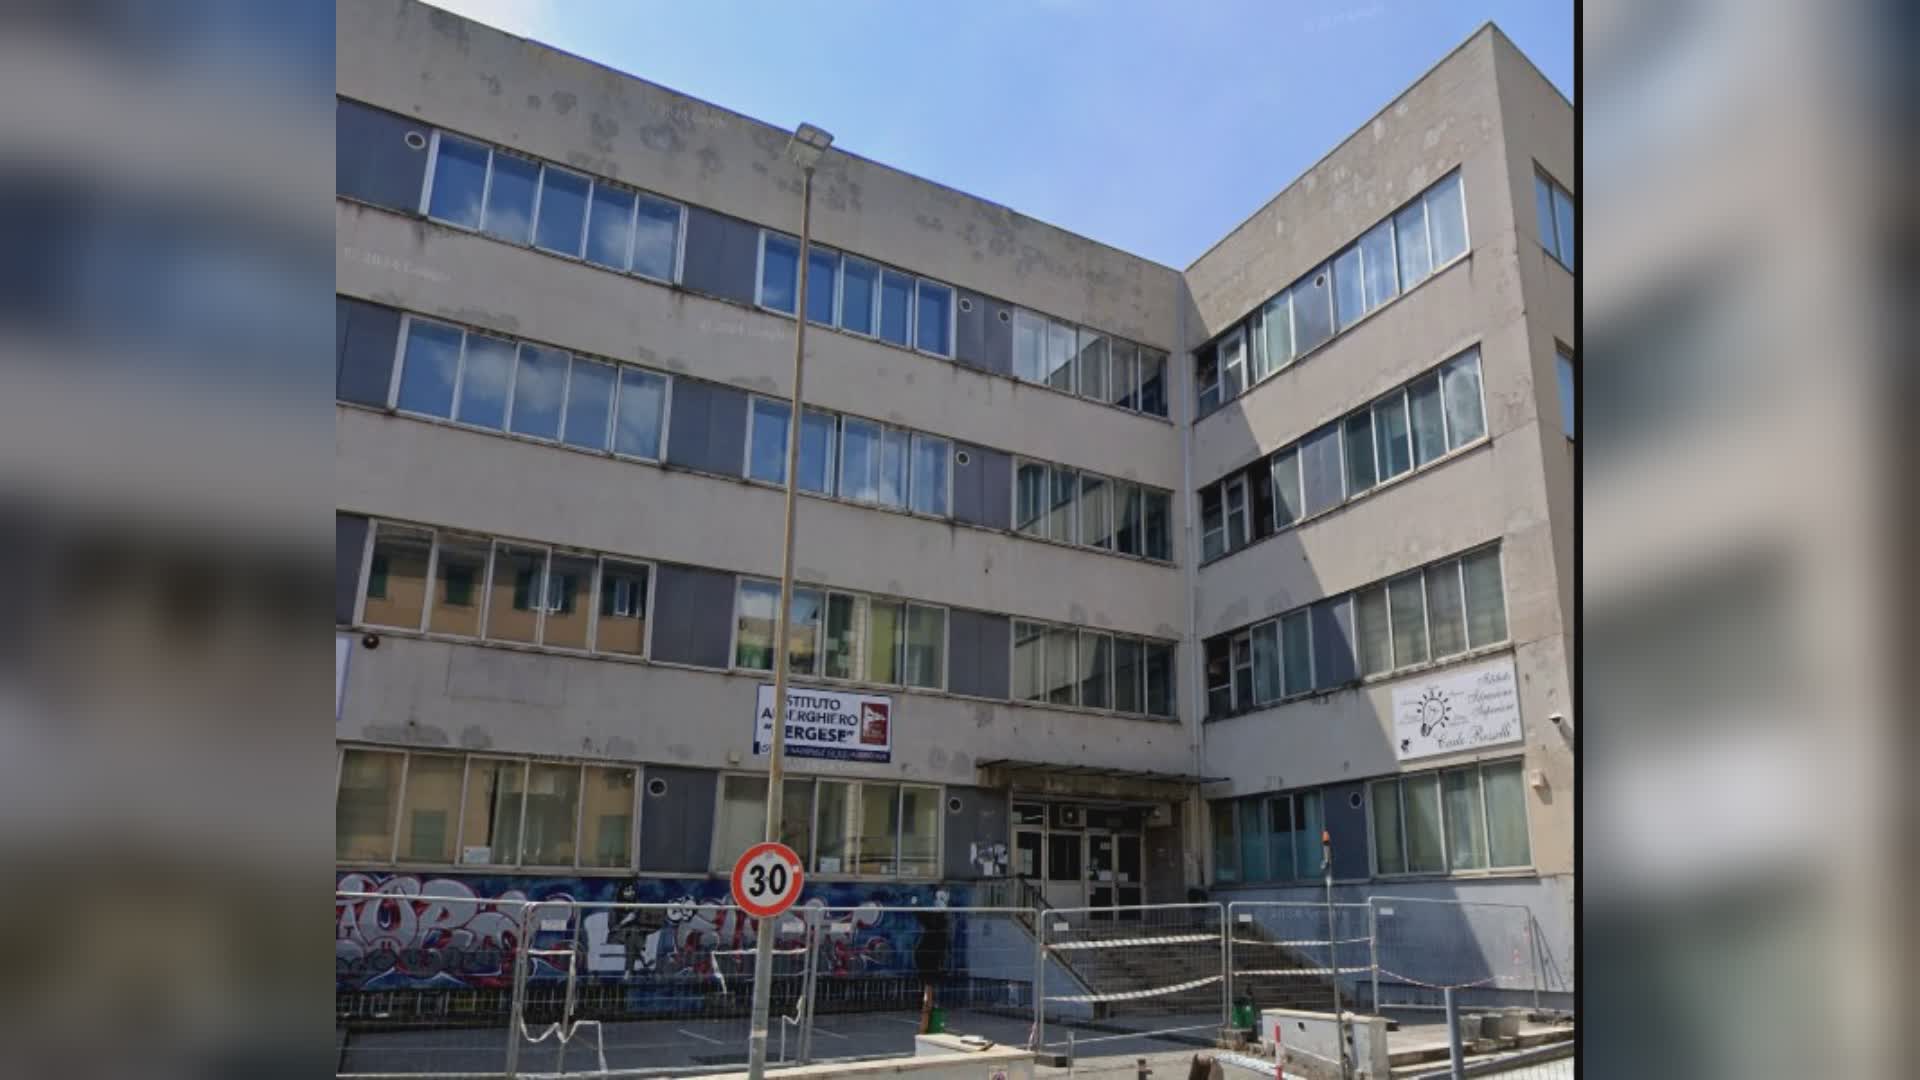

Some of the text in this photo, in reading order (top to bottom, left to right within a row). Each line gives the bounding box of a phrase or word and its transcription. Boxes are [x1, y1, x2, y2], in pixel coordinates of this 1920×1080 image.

[785, 695, 841, 710] STITUTO
[761, 707, 858, 726] AERGHIERO
[763, 723, 855, 742] “ERGESE”
[749, 863, 787, 897] 30
